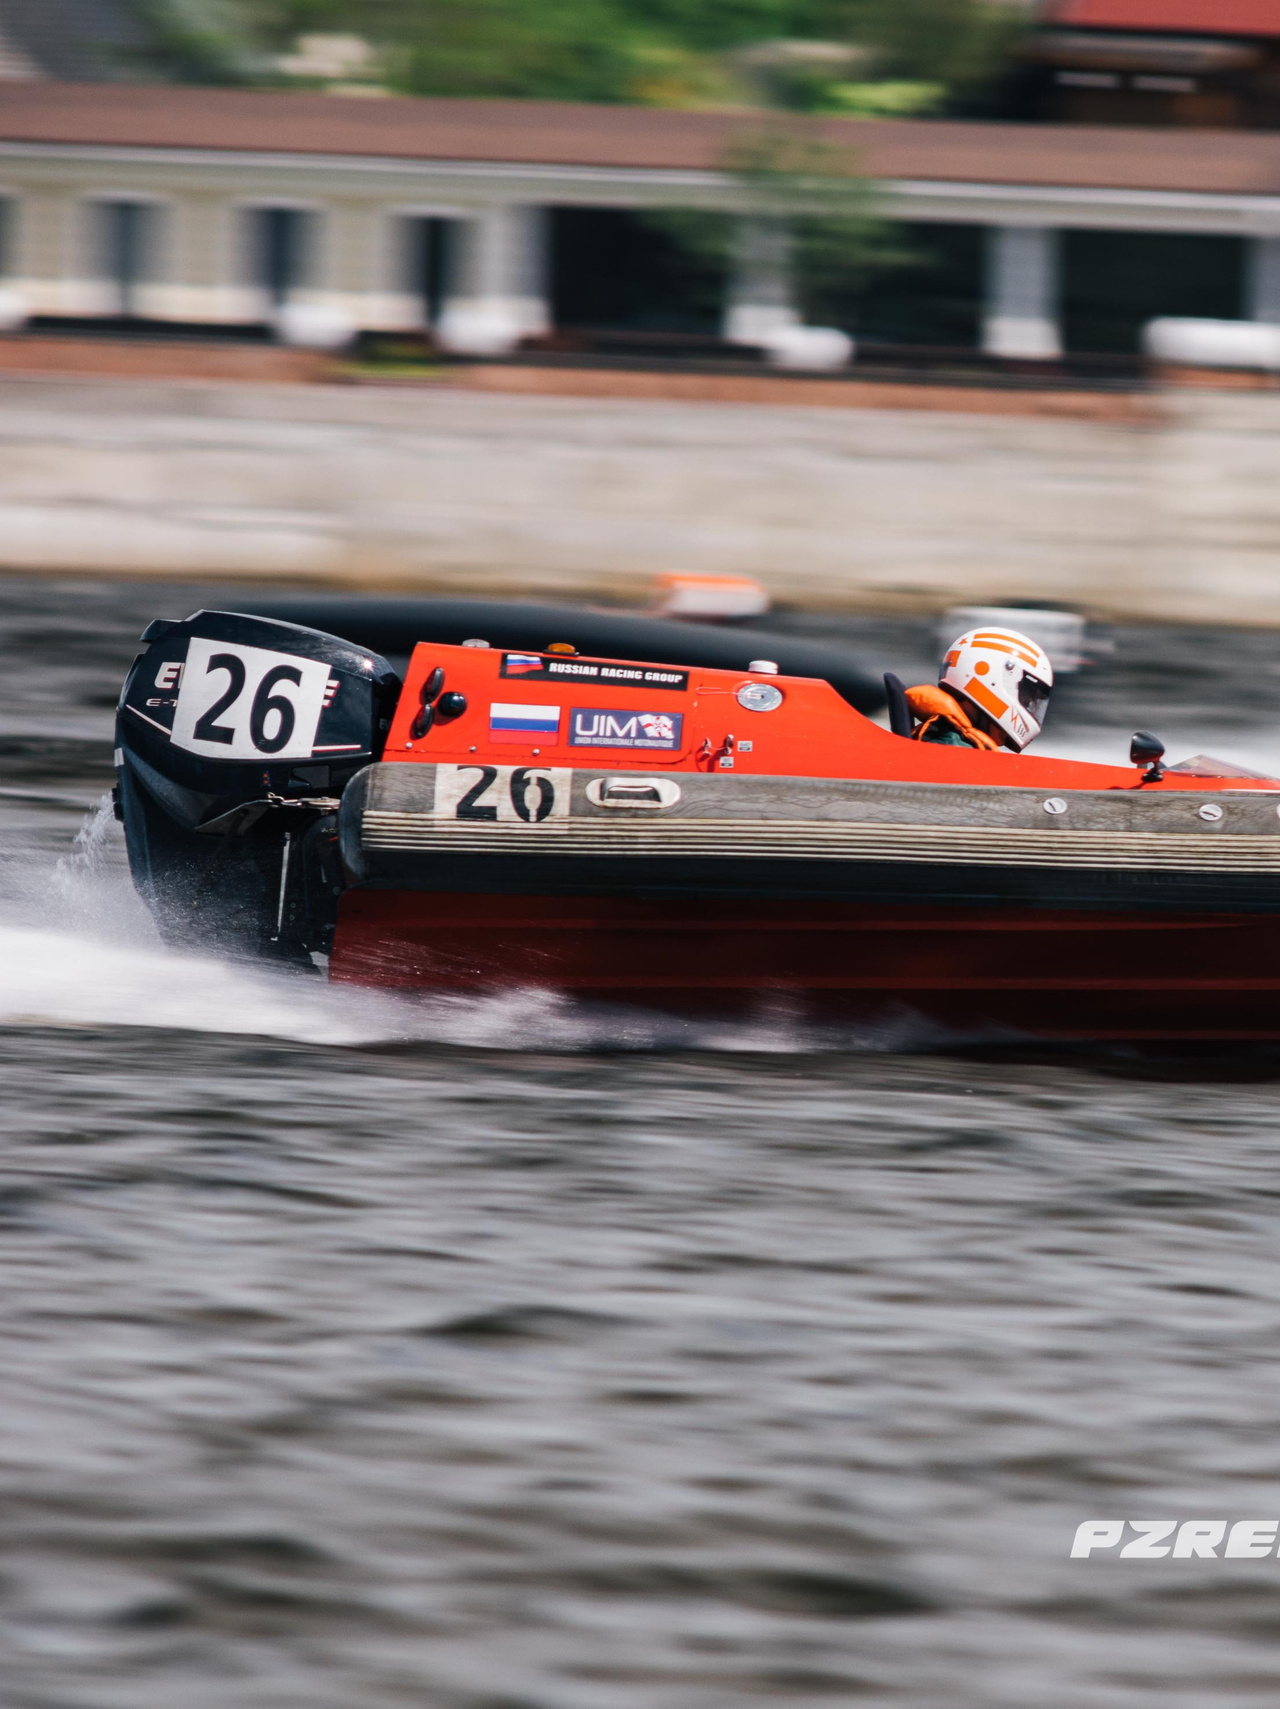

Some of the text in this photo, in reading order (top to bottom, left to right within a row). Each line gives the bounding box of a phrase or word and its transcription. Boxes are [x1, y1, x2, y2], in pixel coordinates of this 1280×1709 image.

[549, 662, 683, 683] RUSSIAN RACING GROUP
[193, 653, 303, 753] 26
[575, 714, 638, 737] UIM
[456, 765, 555, 823] 26
